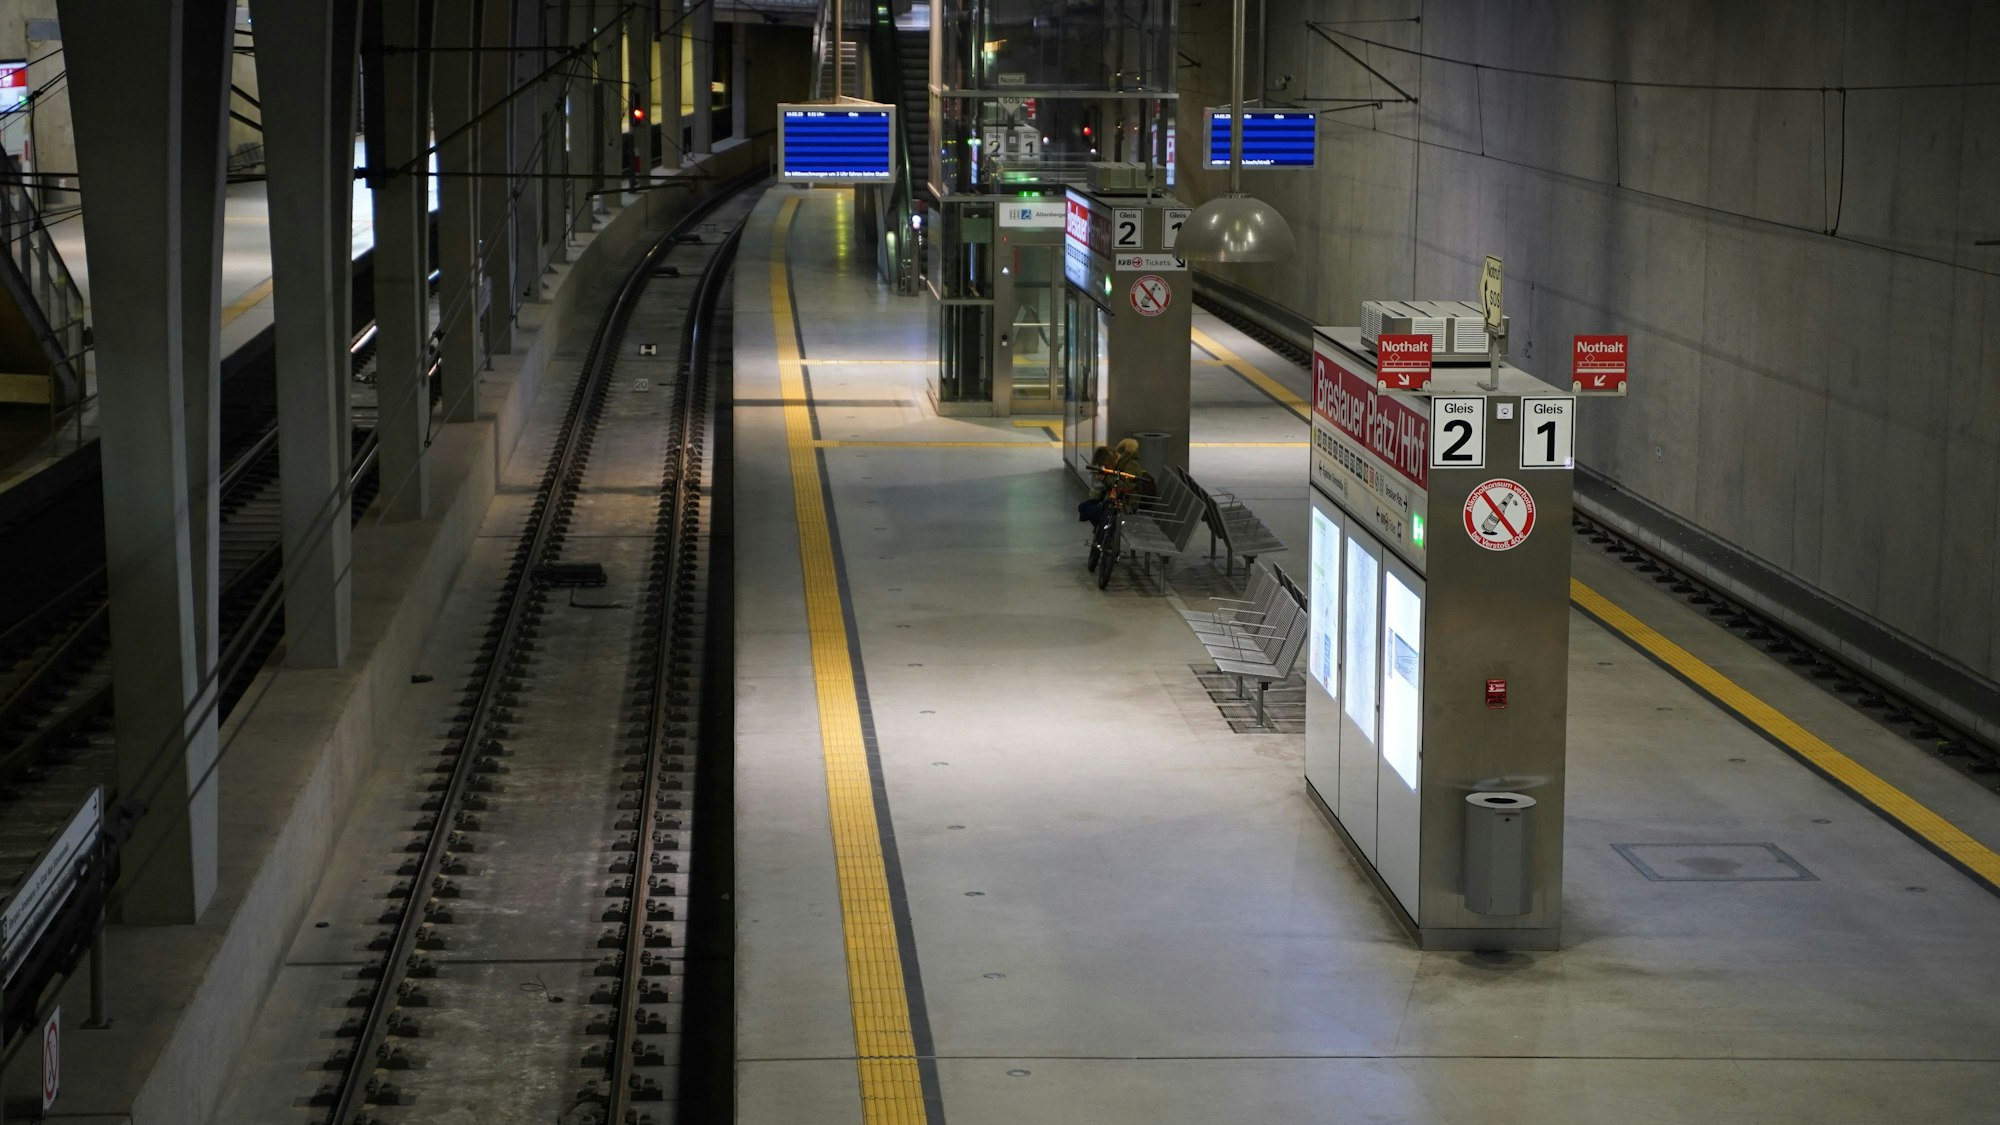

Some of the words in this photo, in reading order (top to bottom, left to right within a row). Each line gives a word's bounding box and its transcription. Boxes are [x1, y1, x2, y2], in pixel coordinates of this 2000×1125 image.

[1119, 211, 1137, 219] Gleis
[1169, 211, 1187, 219] Gleis
[1118, 221, 1136, 245] 2
[1487, 260, 1501, 280] Notruf
[1489, 290, 1500, 308] SOS
[1381, 340, 1429, 353] Nothalt
[1577, 341, 1624, 353] Nothalt
[635, 380, 648, 389] 20
[1444, 402, 1474, 414] Gleis
[1533, 403, 1563, 415] Gleis
[1317, 359, 1365, 438] Breslauer
[1366, 389, 1425, 481] Platz/Hbf
[1441, 419, 1473, 461] 2
[1537, 421, 1556, 462] 1
[1466, 481, 1513, 513] Alkoholkonsum
[1513, 485, 1533, 513] verboten
[1471, 530, 1480, 543] bei
[1482, 539, 1511, 549] Verstoß
[1511, 531, 1526, 546] 40€
